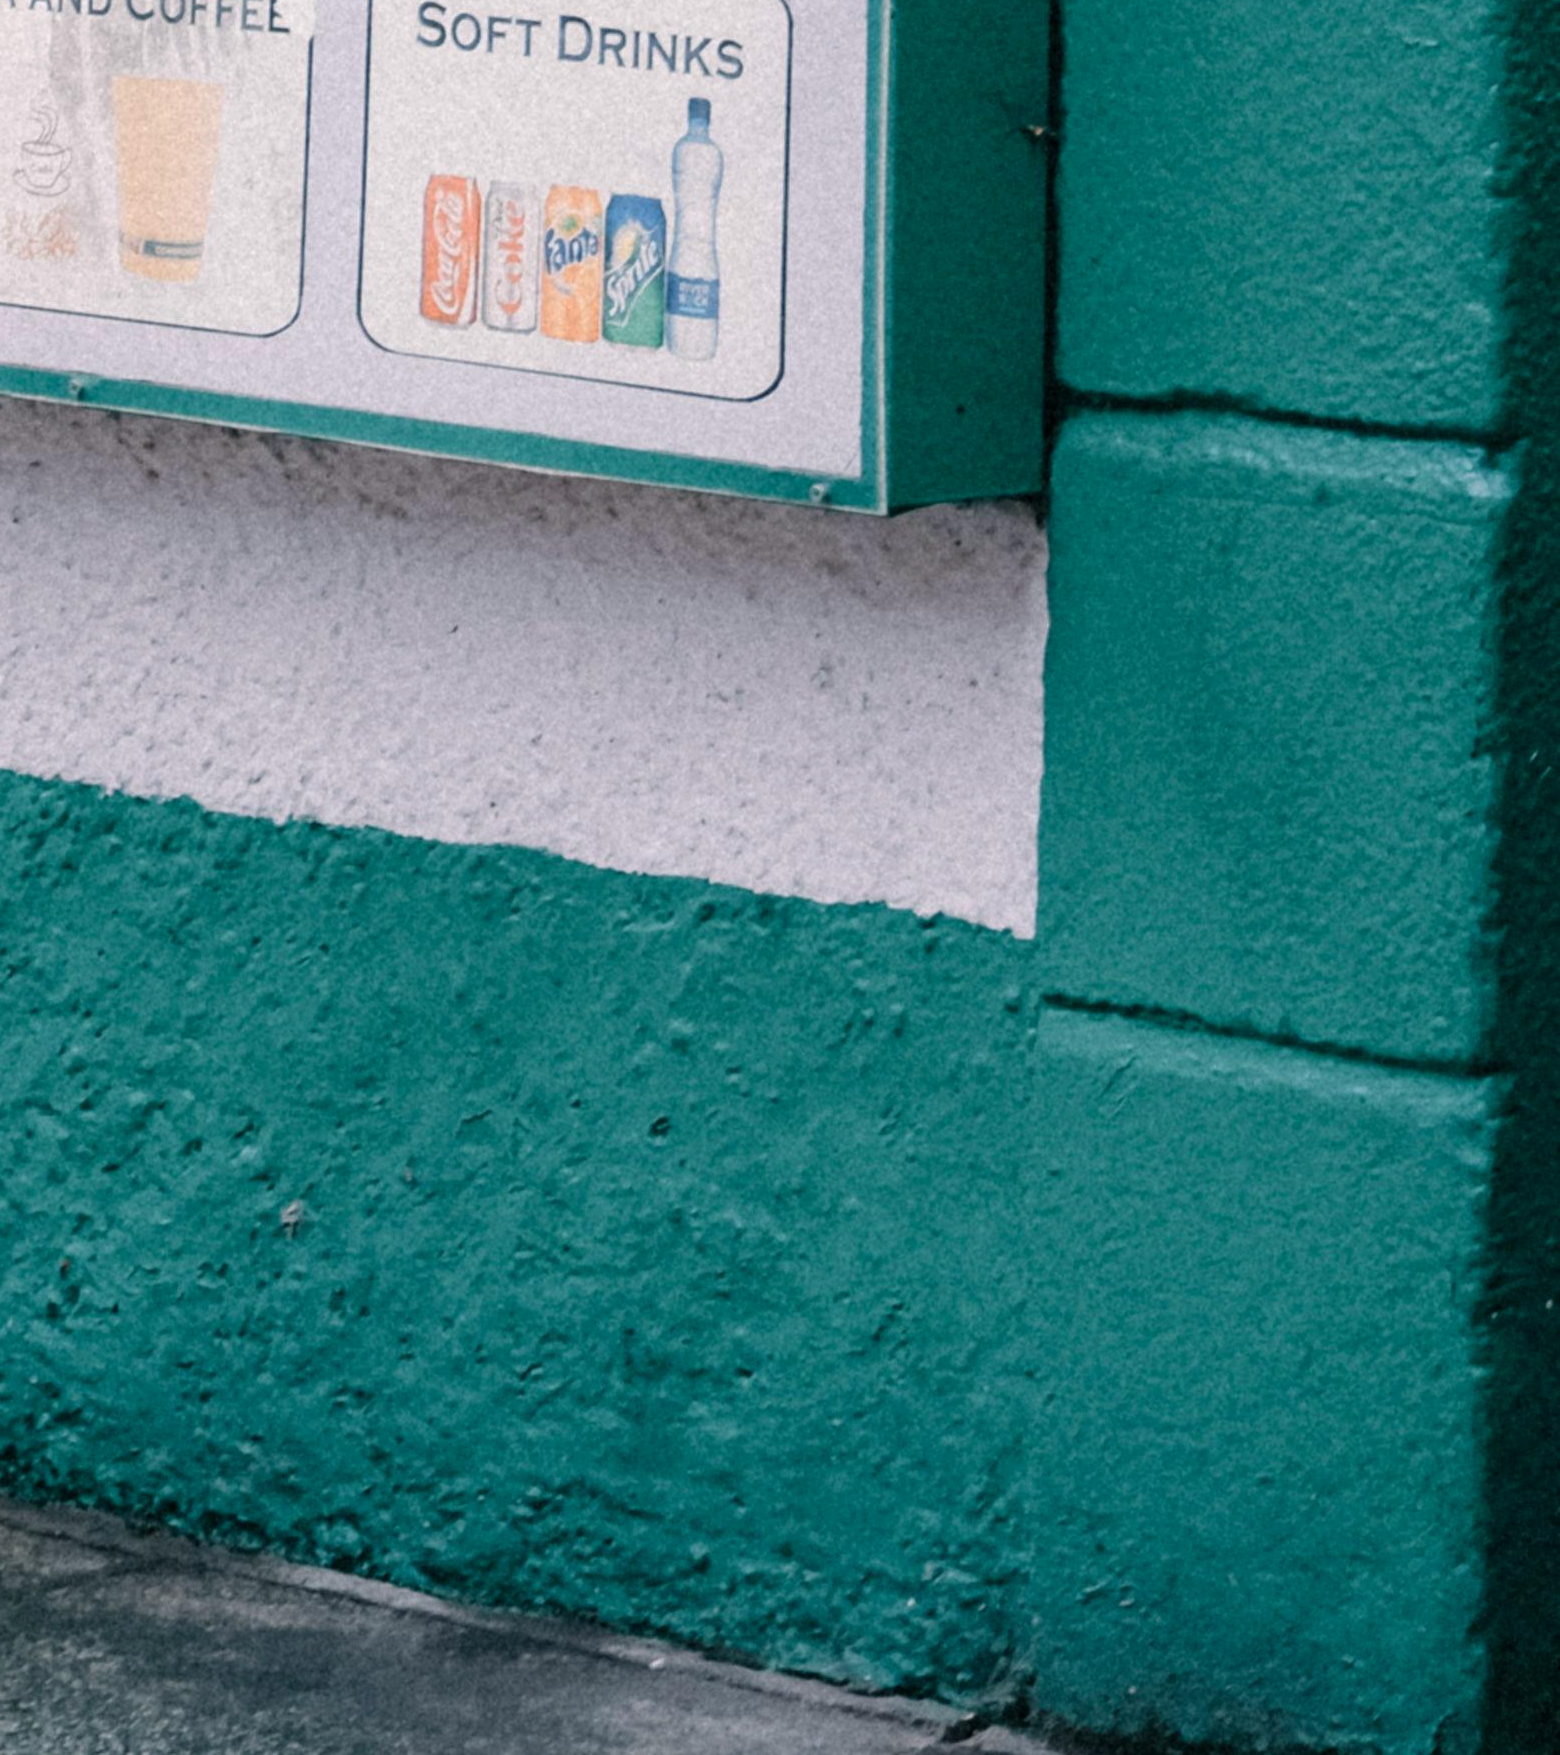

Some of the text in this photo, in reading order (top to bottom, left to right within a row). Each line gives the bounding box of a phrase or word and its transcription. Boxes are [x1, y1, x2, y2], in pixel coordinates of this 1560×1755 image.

[416, 1, 744, 80] SOFT DRINKS
[606, 238, 660, 316] Sprite
